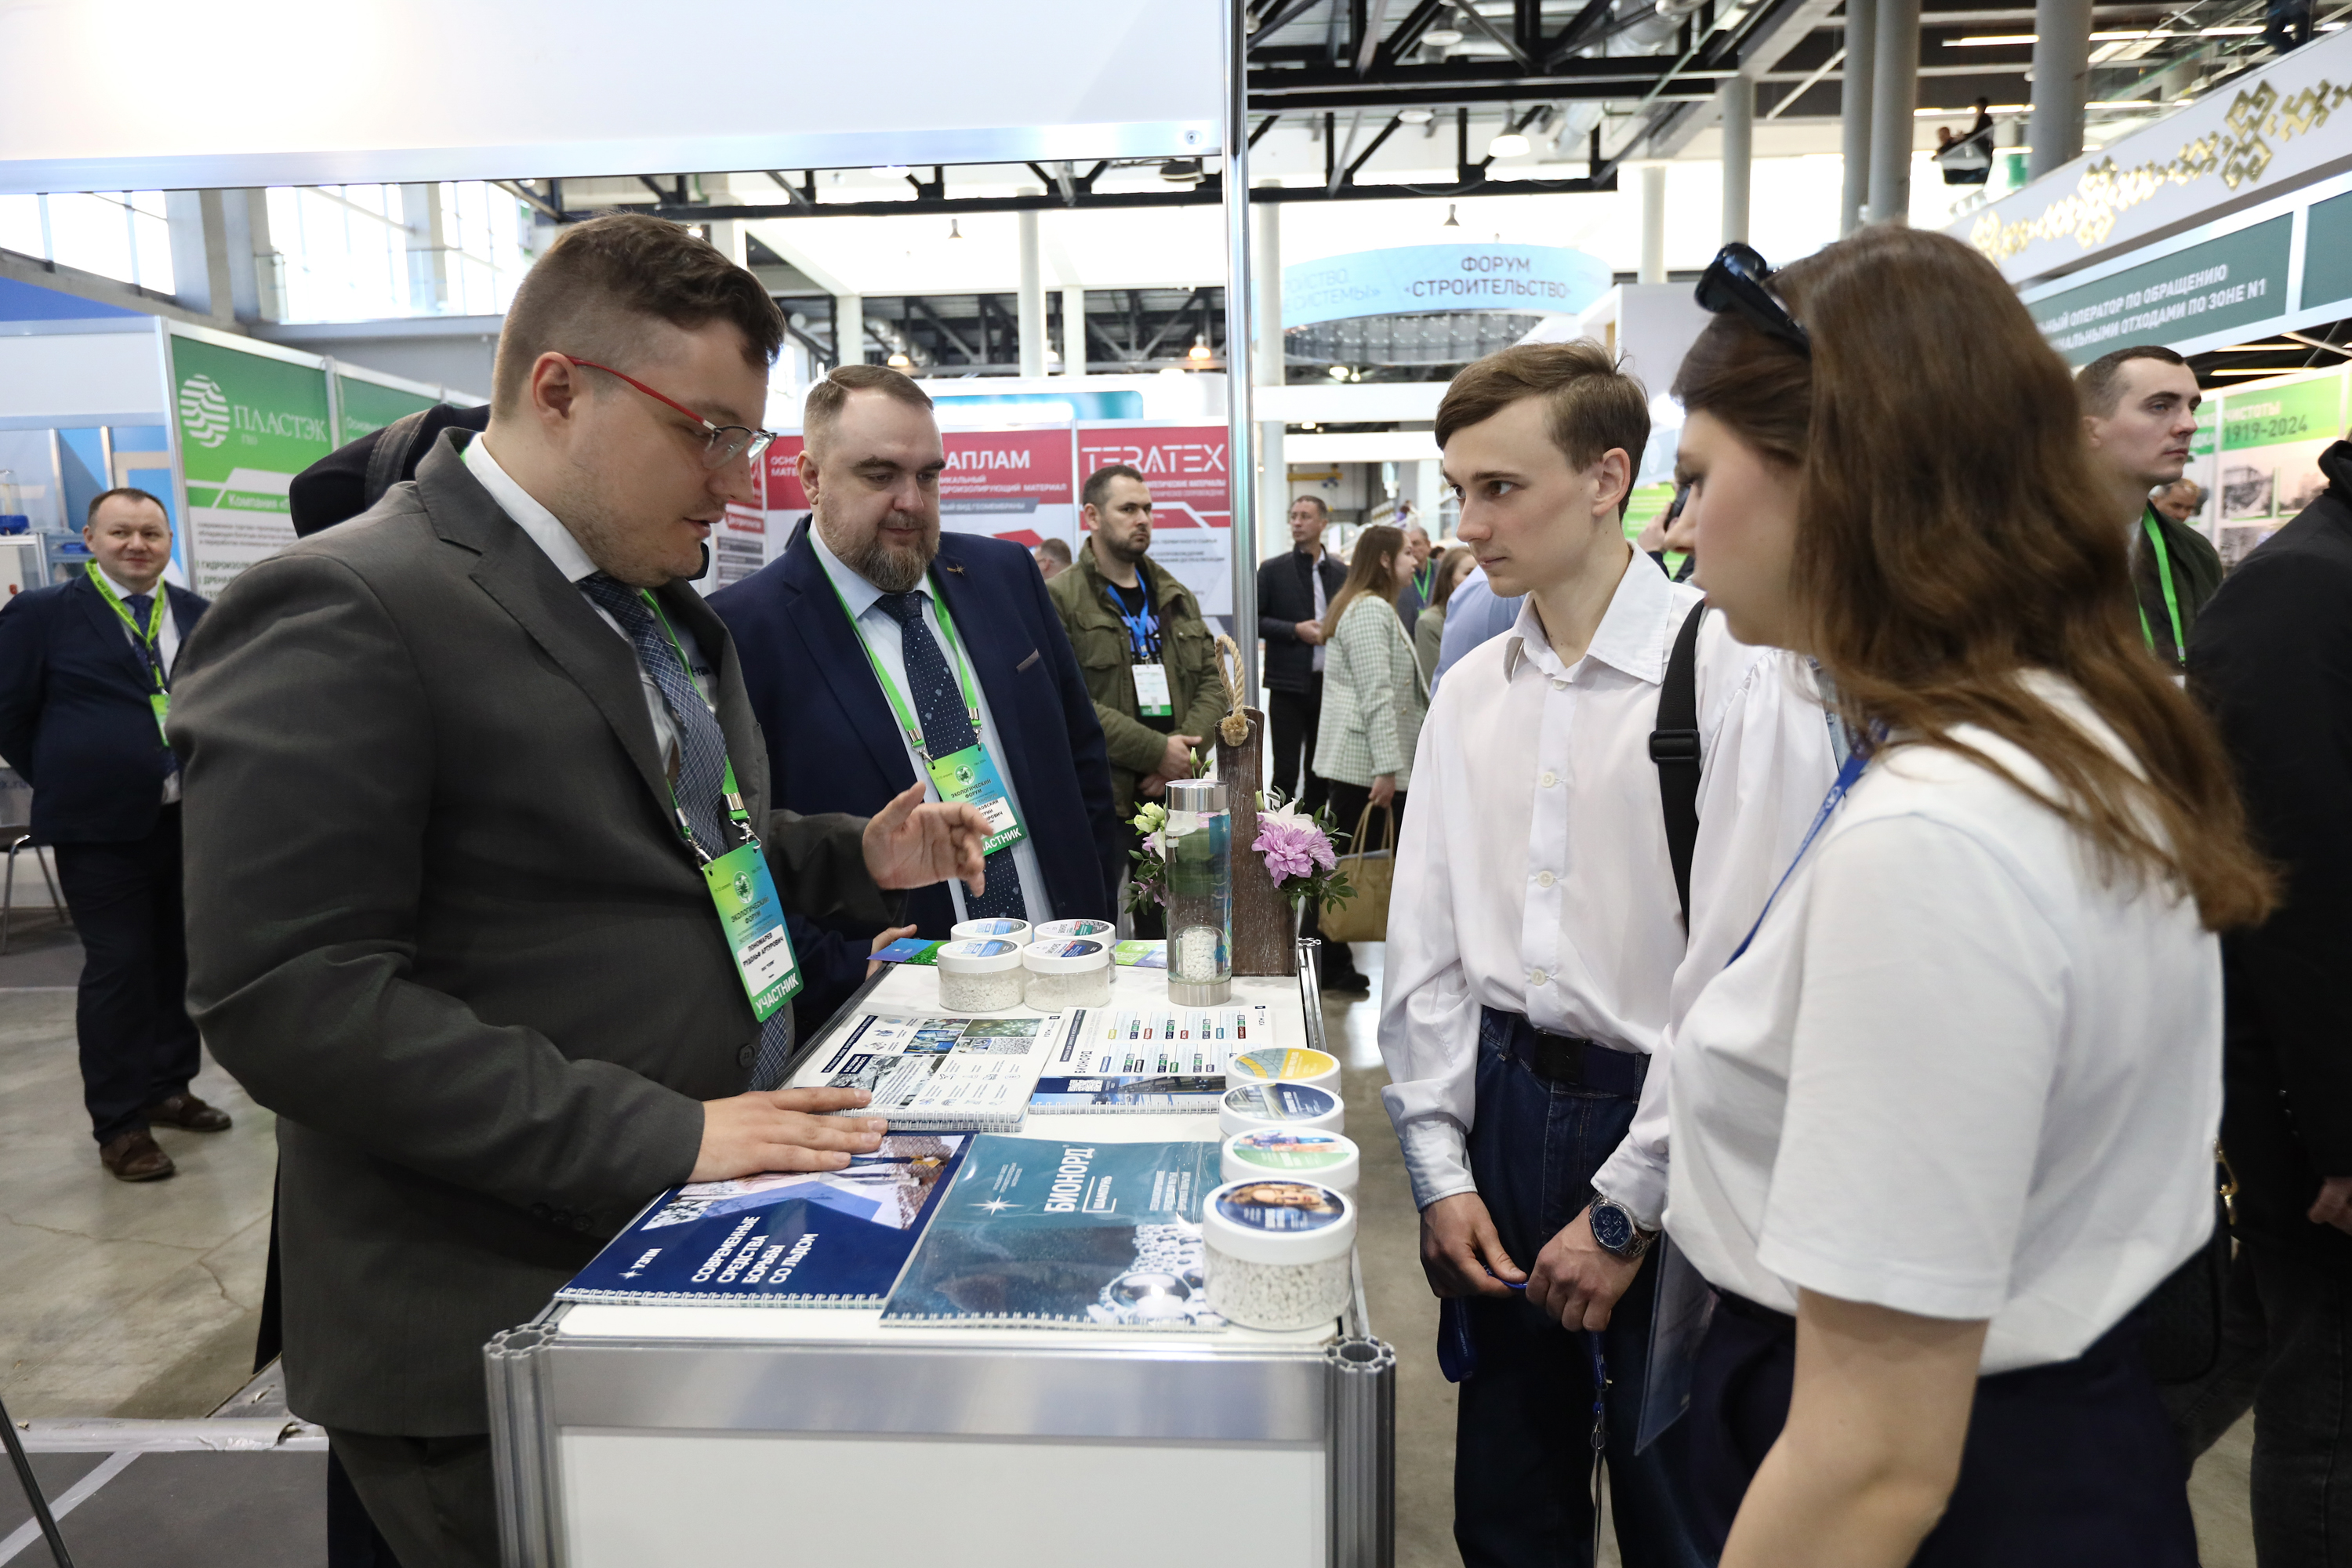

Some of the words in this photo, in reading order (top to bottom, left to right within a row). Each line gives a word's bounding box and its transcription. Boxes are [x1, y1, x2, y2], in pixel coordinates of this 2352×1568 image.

[1461, 256, 1531, 274] ФОРУМ
[1283, 267, 1348, 293] РОЙСТВО
[2036, 311, 2069, 336] ЬНЫЙ
[2070, 296, 2124, 328] ОПЕРАТОР
[2125, 290, 2143, 310] ПО
[2143, 263, 2228, 304] ОБРАЩЕНИЮ
[2049, 321, 2120, 351] НАЛЬНЫМИ
[2120, 303, 2186, 335] ОТХОДАМИ
[2187, 296, 2207, 316] ПО
[2208, 283, 2245, 310] ЗОНЕ
[2247, 277, 2267, 299] N1
[233, 405, 328, 442] ПЛАСТЭК
[2225, 414, 2309, 444] 1919-2024
[770, 456, 797, 466] ОСНО
[771, 468, 798, 477] МАТЕ
[944, 449, 1031, 470] АПЛАМ
[1081, 444, 1226, 474] TERATEX
[1023, 483, 1068, 492] МАТЕРИАЛ
[950, 779, 993, 799] ЭКОЛОГИЧЕСКИЙ
[964, 788, 983, 799] ФОРУМ
[981, 808, 993, 817] ТРИЙ
[985, 811, 1004, 821] РОВИЧ
[731, 895, 770, 924] ЭКОЛОГИЧЕСКИЙ
[745, 909, 761, 924] ФОРУМ
[742, 951, 762, 968] РУДОЛЬФ
[760, 935, 784, 956] АРТУРОВИЧ
[747, 931, 773, 953] ПОНОМАРЕВ
[755, 972, 800, 1014] УЧАСТНИК
[1074, 1050, 1093, 1073] БИОНОРД
[1044, 1147, 1095, 1212] БИОНОРД
[1092, 1175, 1112, 1210] ШАМПУНЬ
[632, 1247, 663, 1269] УЗПМ
[690, 1216, 761, 1283] СОВРЕМЕННЫЕ
[716, 1234, 769, 1284] СРЕДСТВА
[768, 1265, 789, 1284] СО
[782, 1232, 819, 1272] ЛЬДОМ
[741, 1244, 786, 1284] БОРЬБЫ
